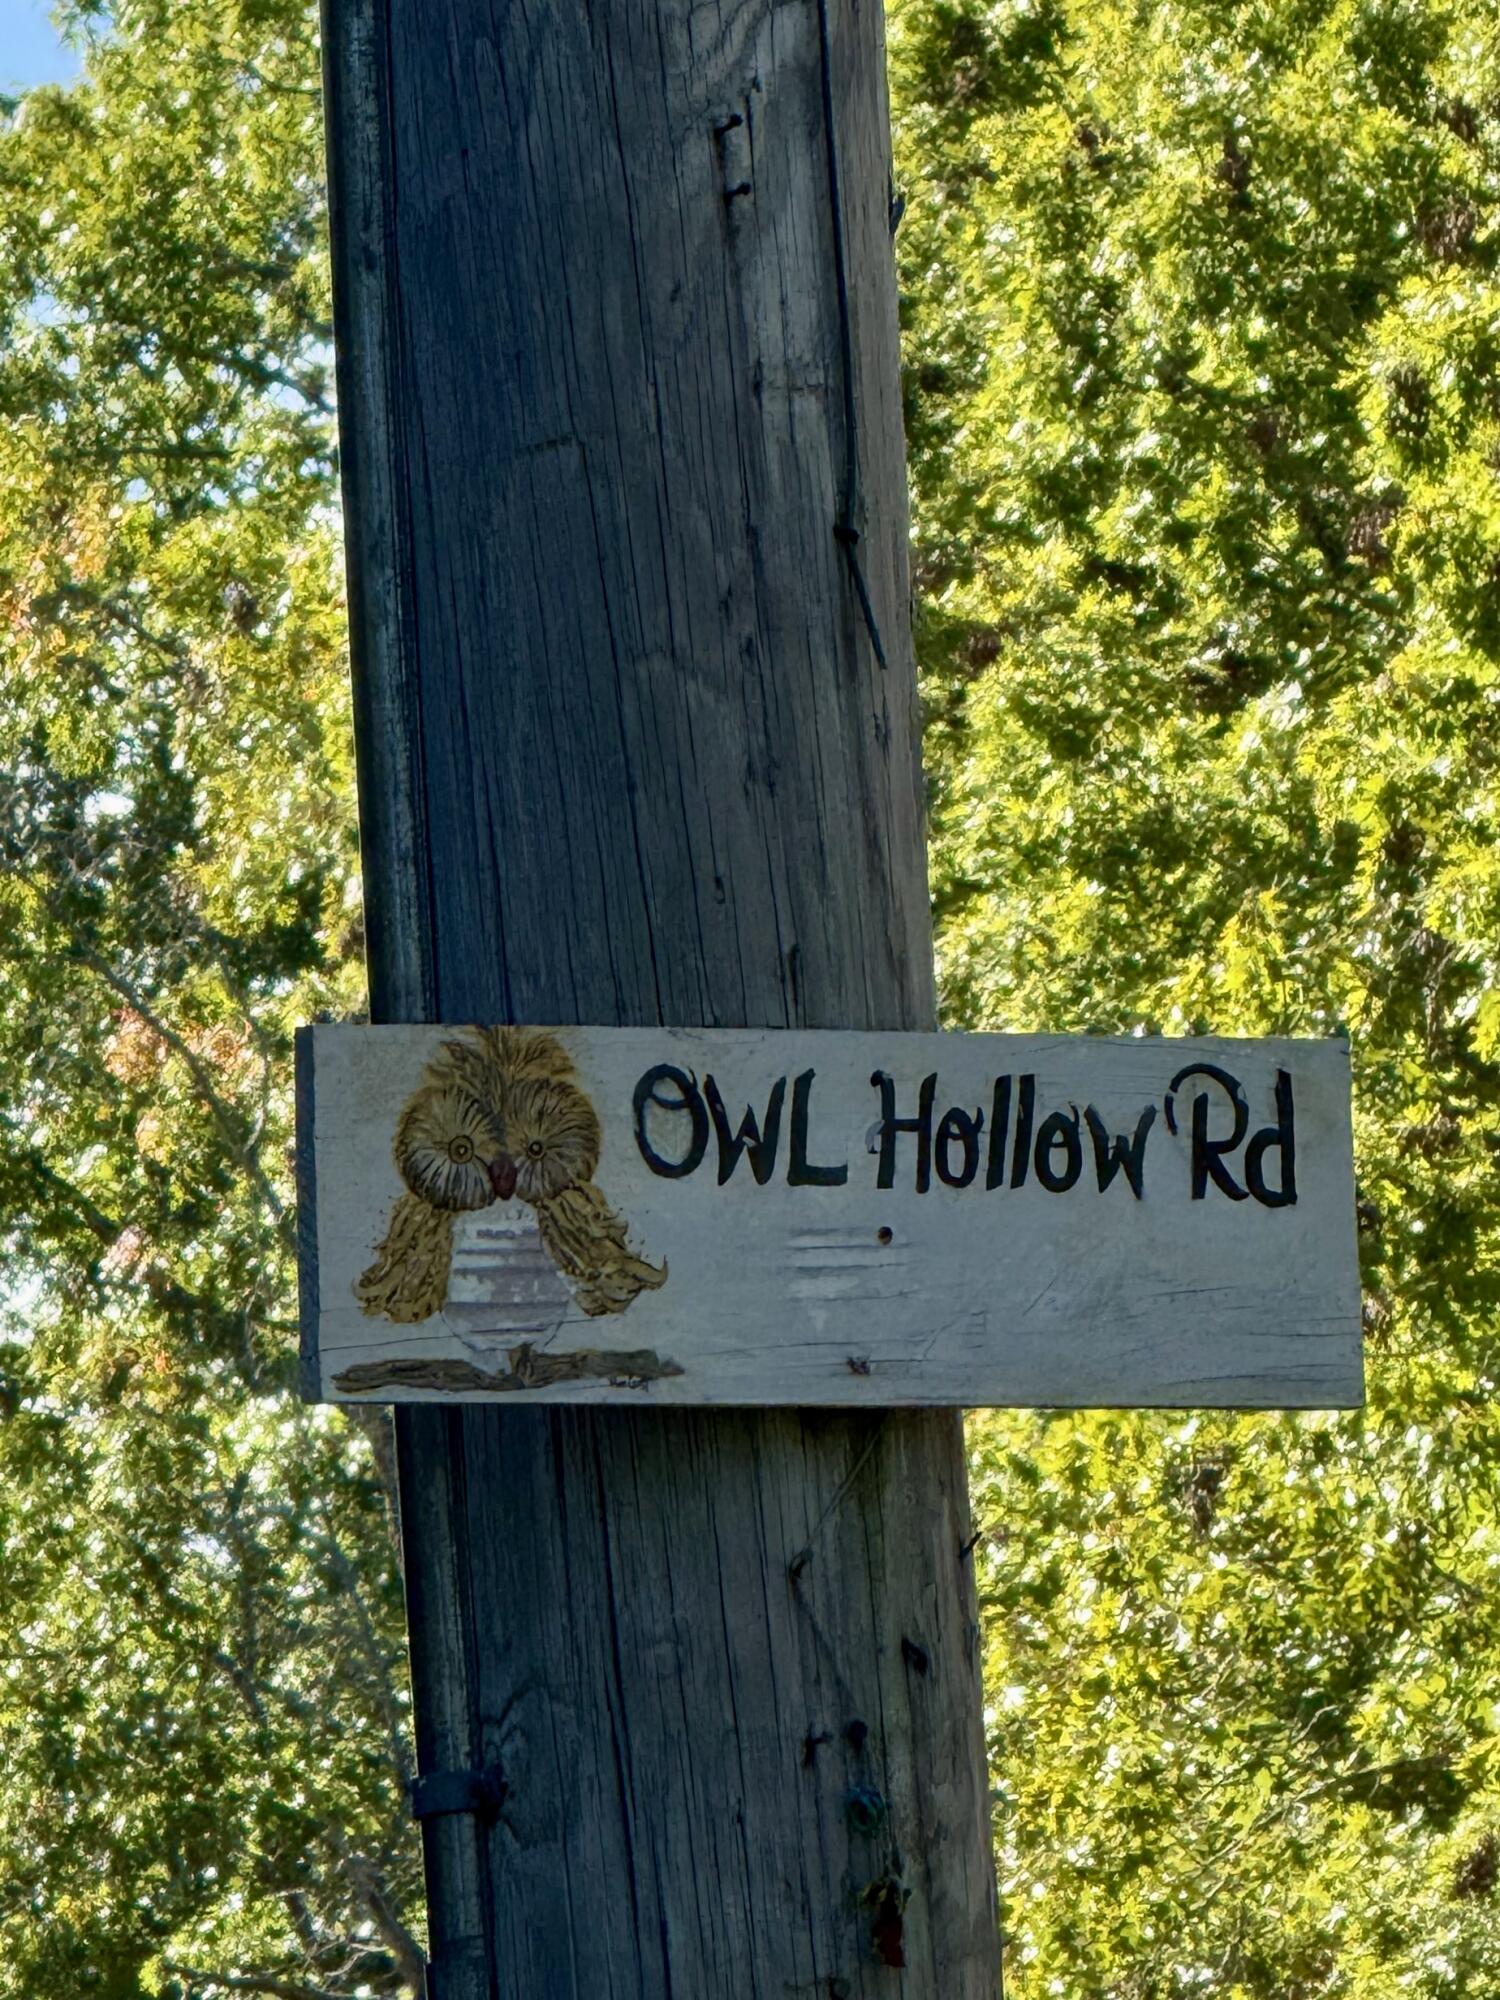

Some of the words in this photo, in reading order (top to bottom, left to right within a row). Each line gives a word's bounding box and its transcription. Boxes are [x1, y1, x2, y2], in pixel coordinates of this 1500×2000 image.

[634, 1063, 848, 1187] OWL
[867, 1070, 1157, 1200] Hollow
[1165, 1062, 1297, 1208] Rd
